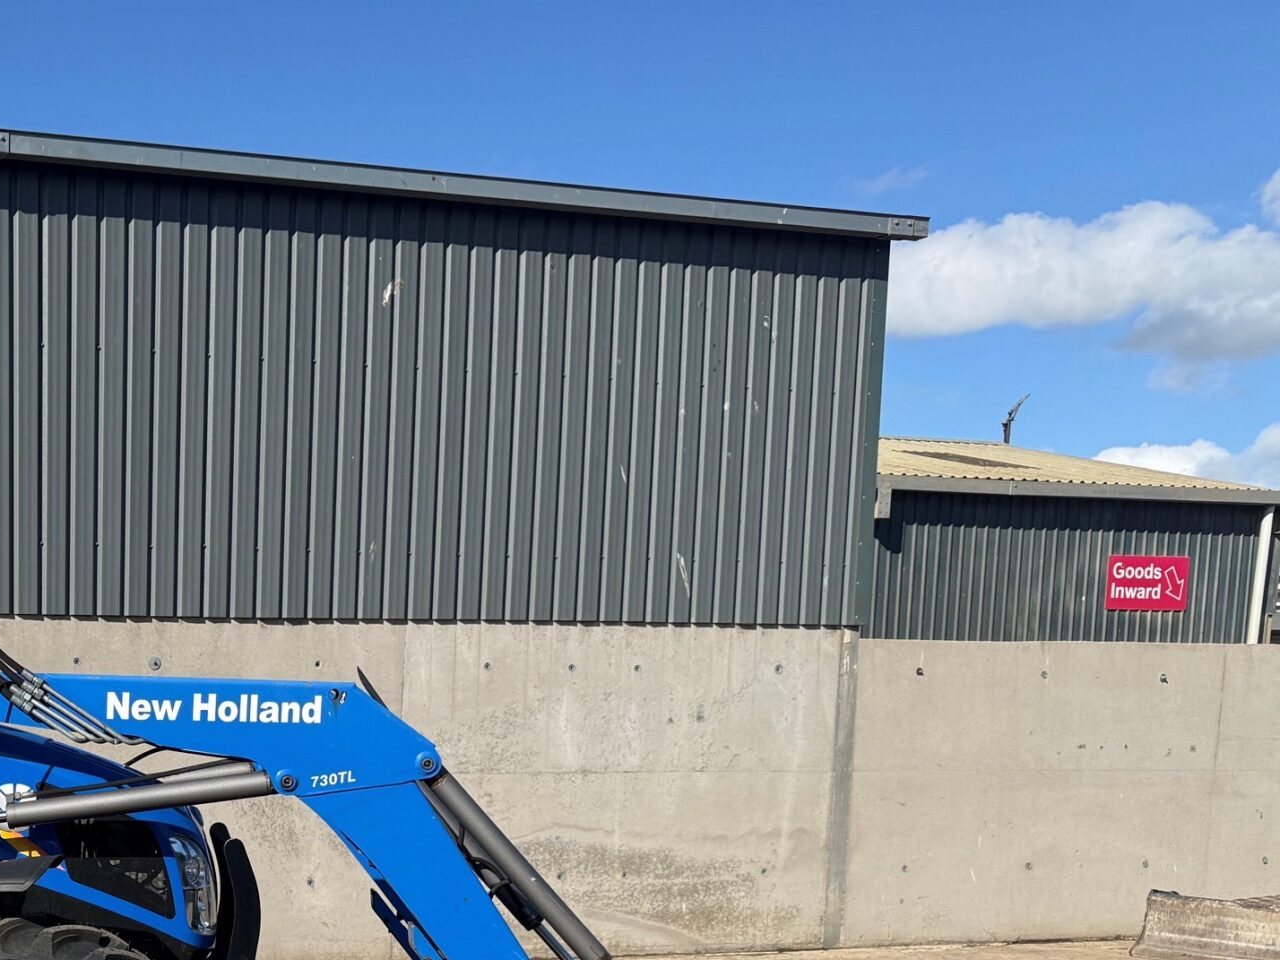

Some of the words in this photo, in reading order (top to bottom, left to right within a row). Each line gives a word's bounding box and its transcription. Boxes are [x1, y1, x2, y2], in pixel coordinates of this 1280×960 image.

[1112, 562, 1162, 580] Goods
[1110, 582, 1162, 600] Inward
[106, 691, 182, 722] New
[192, 692, 324, 724] Holland
[310, 770, 356, 788] 730TL
